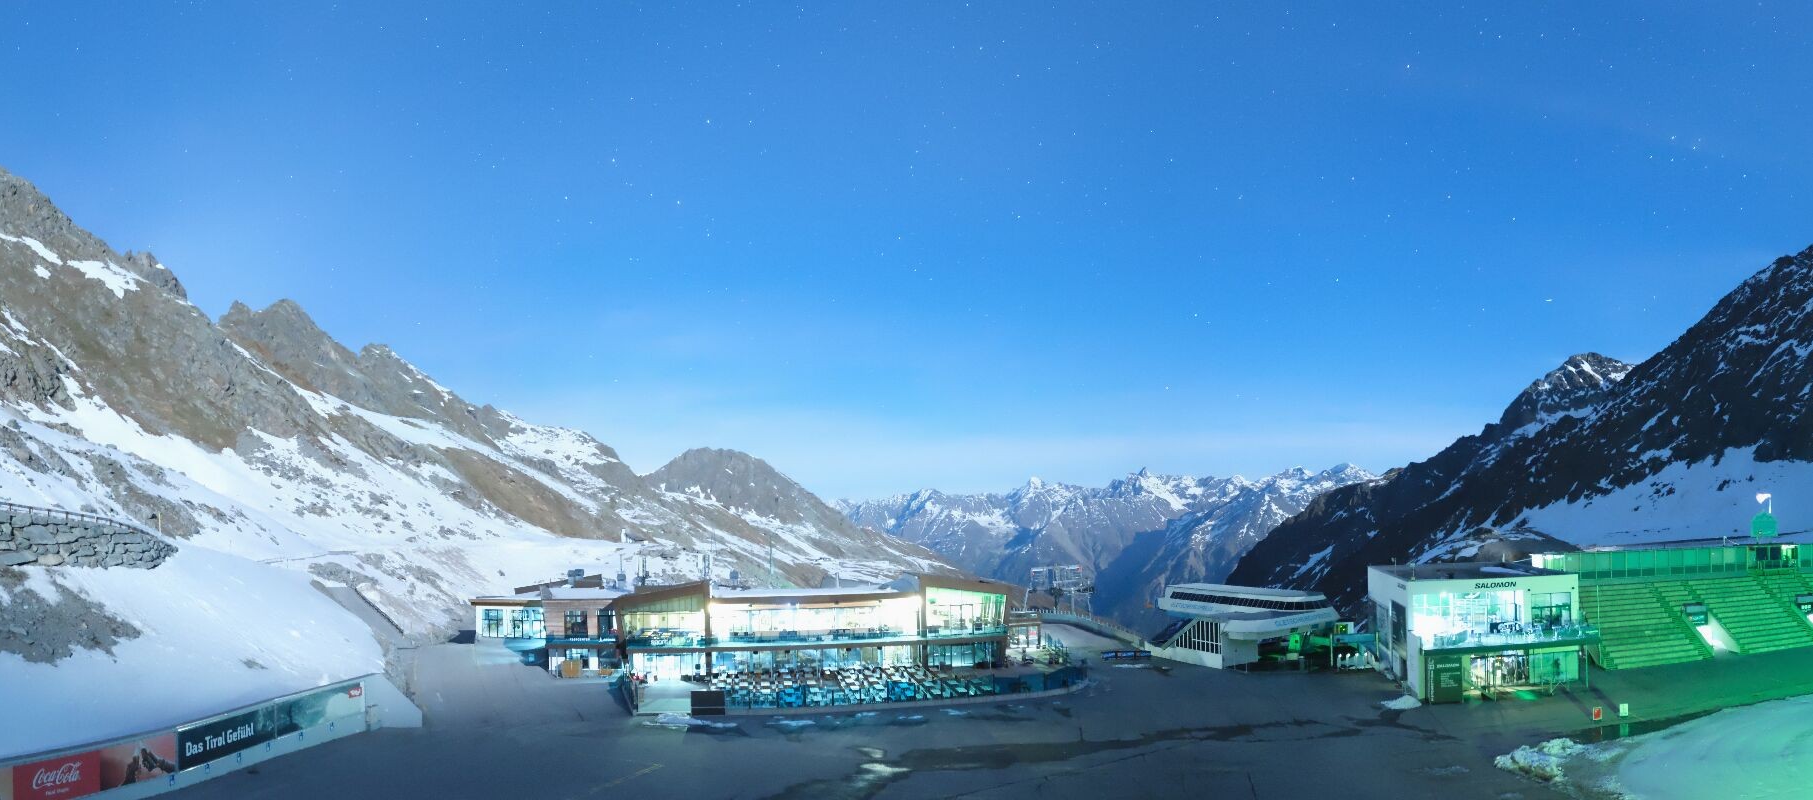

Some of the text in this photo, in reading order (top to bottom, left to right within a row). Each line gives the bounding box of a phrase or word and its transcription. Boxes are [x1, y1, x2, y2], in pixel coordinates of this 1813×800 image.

[1474, 581, 1516, 590] SALOMON
[185, 722, 254, 757] Das Tirol Gefühl
[32, 761, 82, 790] Coca-Cola
